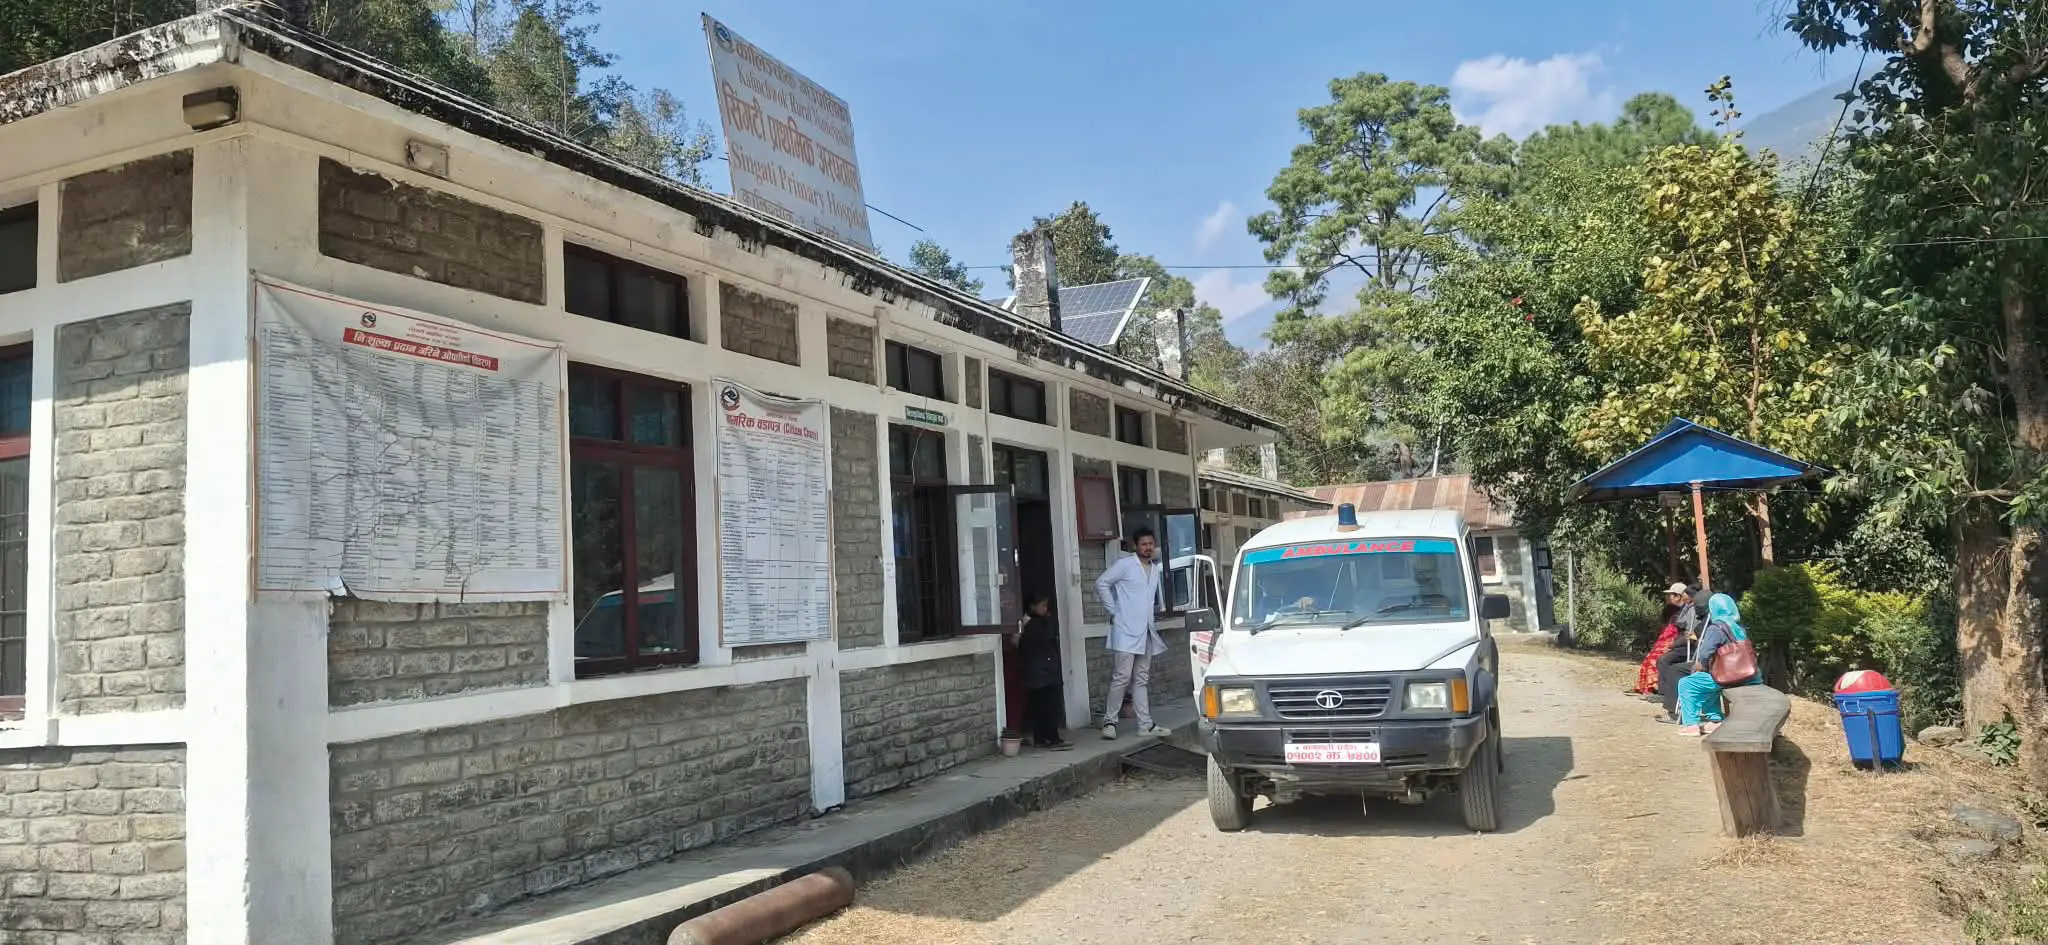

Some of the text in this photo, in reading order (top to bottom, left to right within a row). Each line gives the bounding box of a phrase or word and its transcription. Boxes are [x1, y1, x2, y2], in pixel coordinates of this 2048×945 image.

[766, 115, 815, 167] प्राथमिक
[816, 143, 860, 194] अस्पताल
[731, 142, 777, 186] Singati
[778, 165, 825, 215] Primary
[825, 190, 870, 229] Hospital
[393, 341, 417, 353] प्रदान
[756, 418, 780, 433] वडापत्र
[1280, 541, 1417, 559] AMBULANCE
